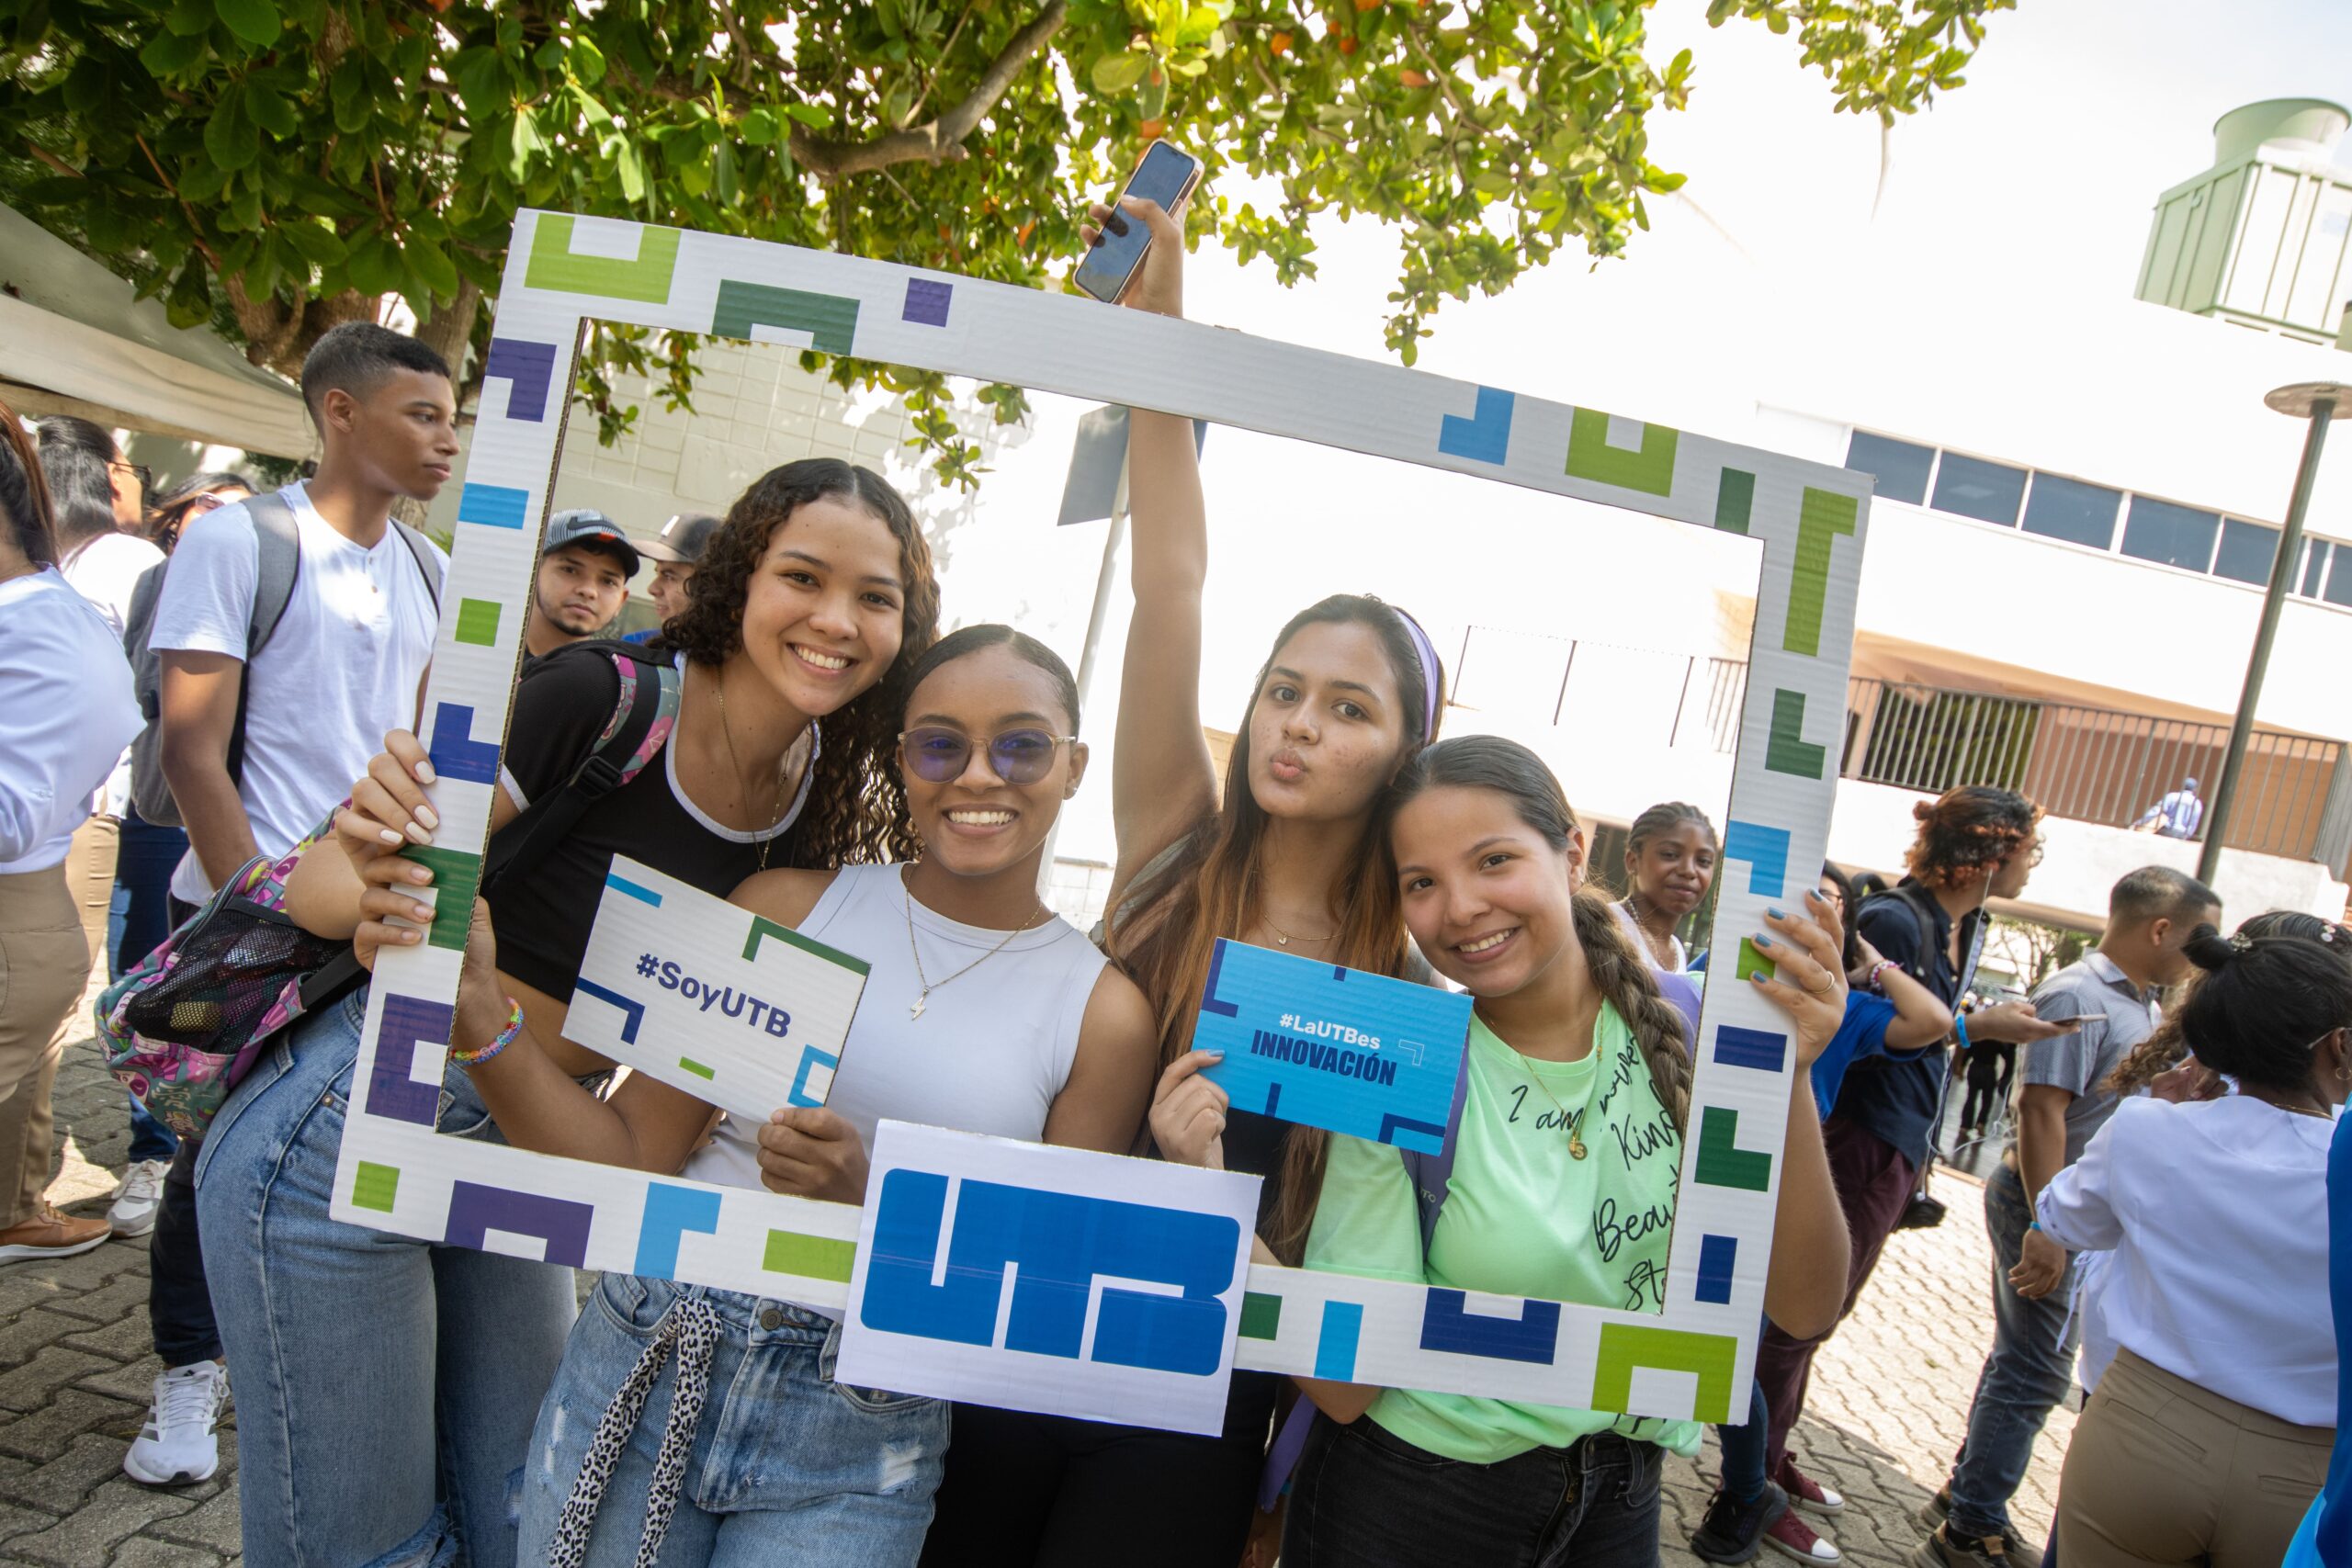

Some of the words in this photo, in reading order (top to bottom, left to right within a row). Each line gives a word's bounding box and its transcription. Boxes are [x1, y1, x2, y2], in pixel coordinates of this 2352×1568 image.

[637, 953, 791, 1038] #SoyUTB
[1250, 1029, 1396, 1086] INNOVACIÓN
[1279, 1013, 1381, 1049] #LaUTBes
[1536, 1107, 1584, 1132] am
[1593, 1193, 1676, 1263] Beau
[860, 1168, 1241, 1377] UTB
[1623, 1258, 1667, 1311] St
